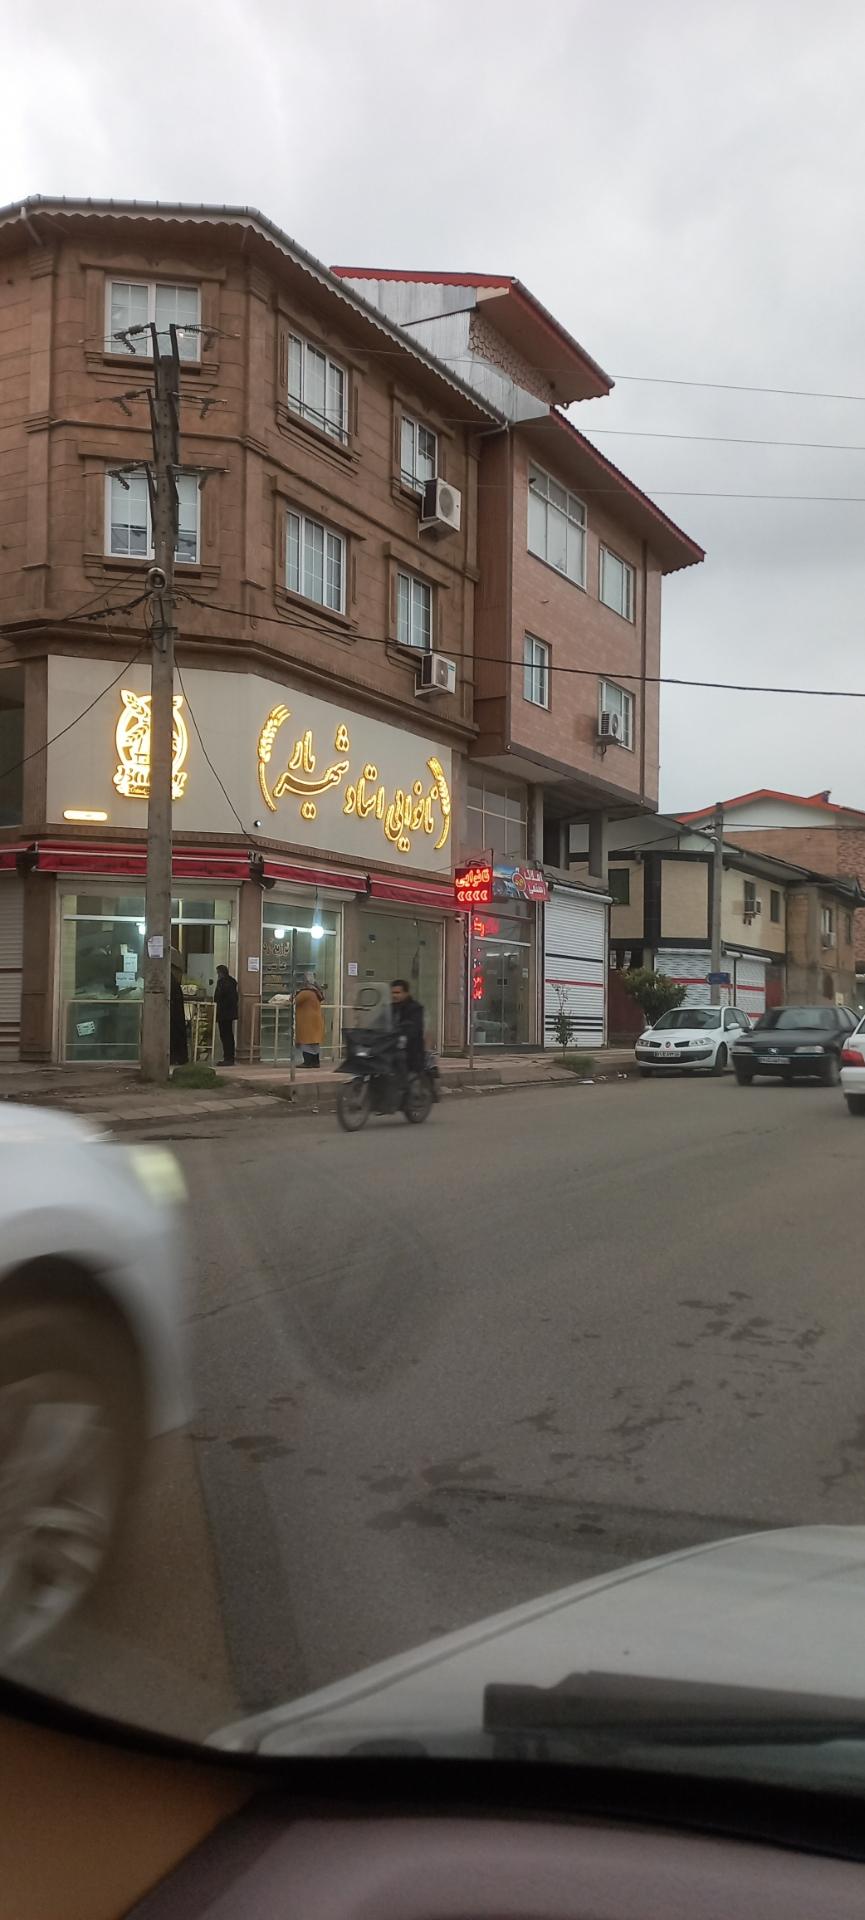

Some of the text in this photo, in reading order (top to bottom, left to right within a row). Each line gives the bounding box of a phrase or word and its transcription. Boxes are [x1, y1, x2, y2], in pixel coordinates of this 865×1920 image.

[343, 763, 386, 820] استاد
[384, 780, 438, 853] نانوایی
[455, 868, 490, 888] نانوایی
